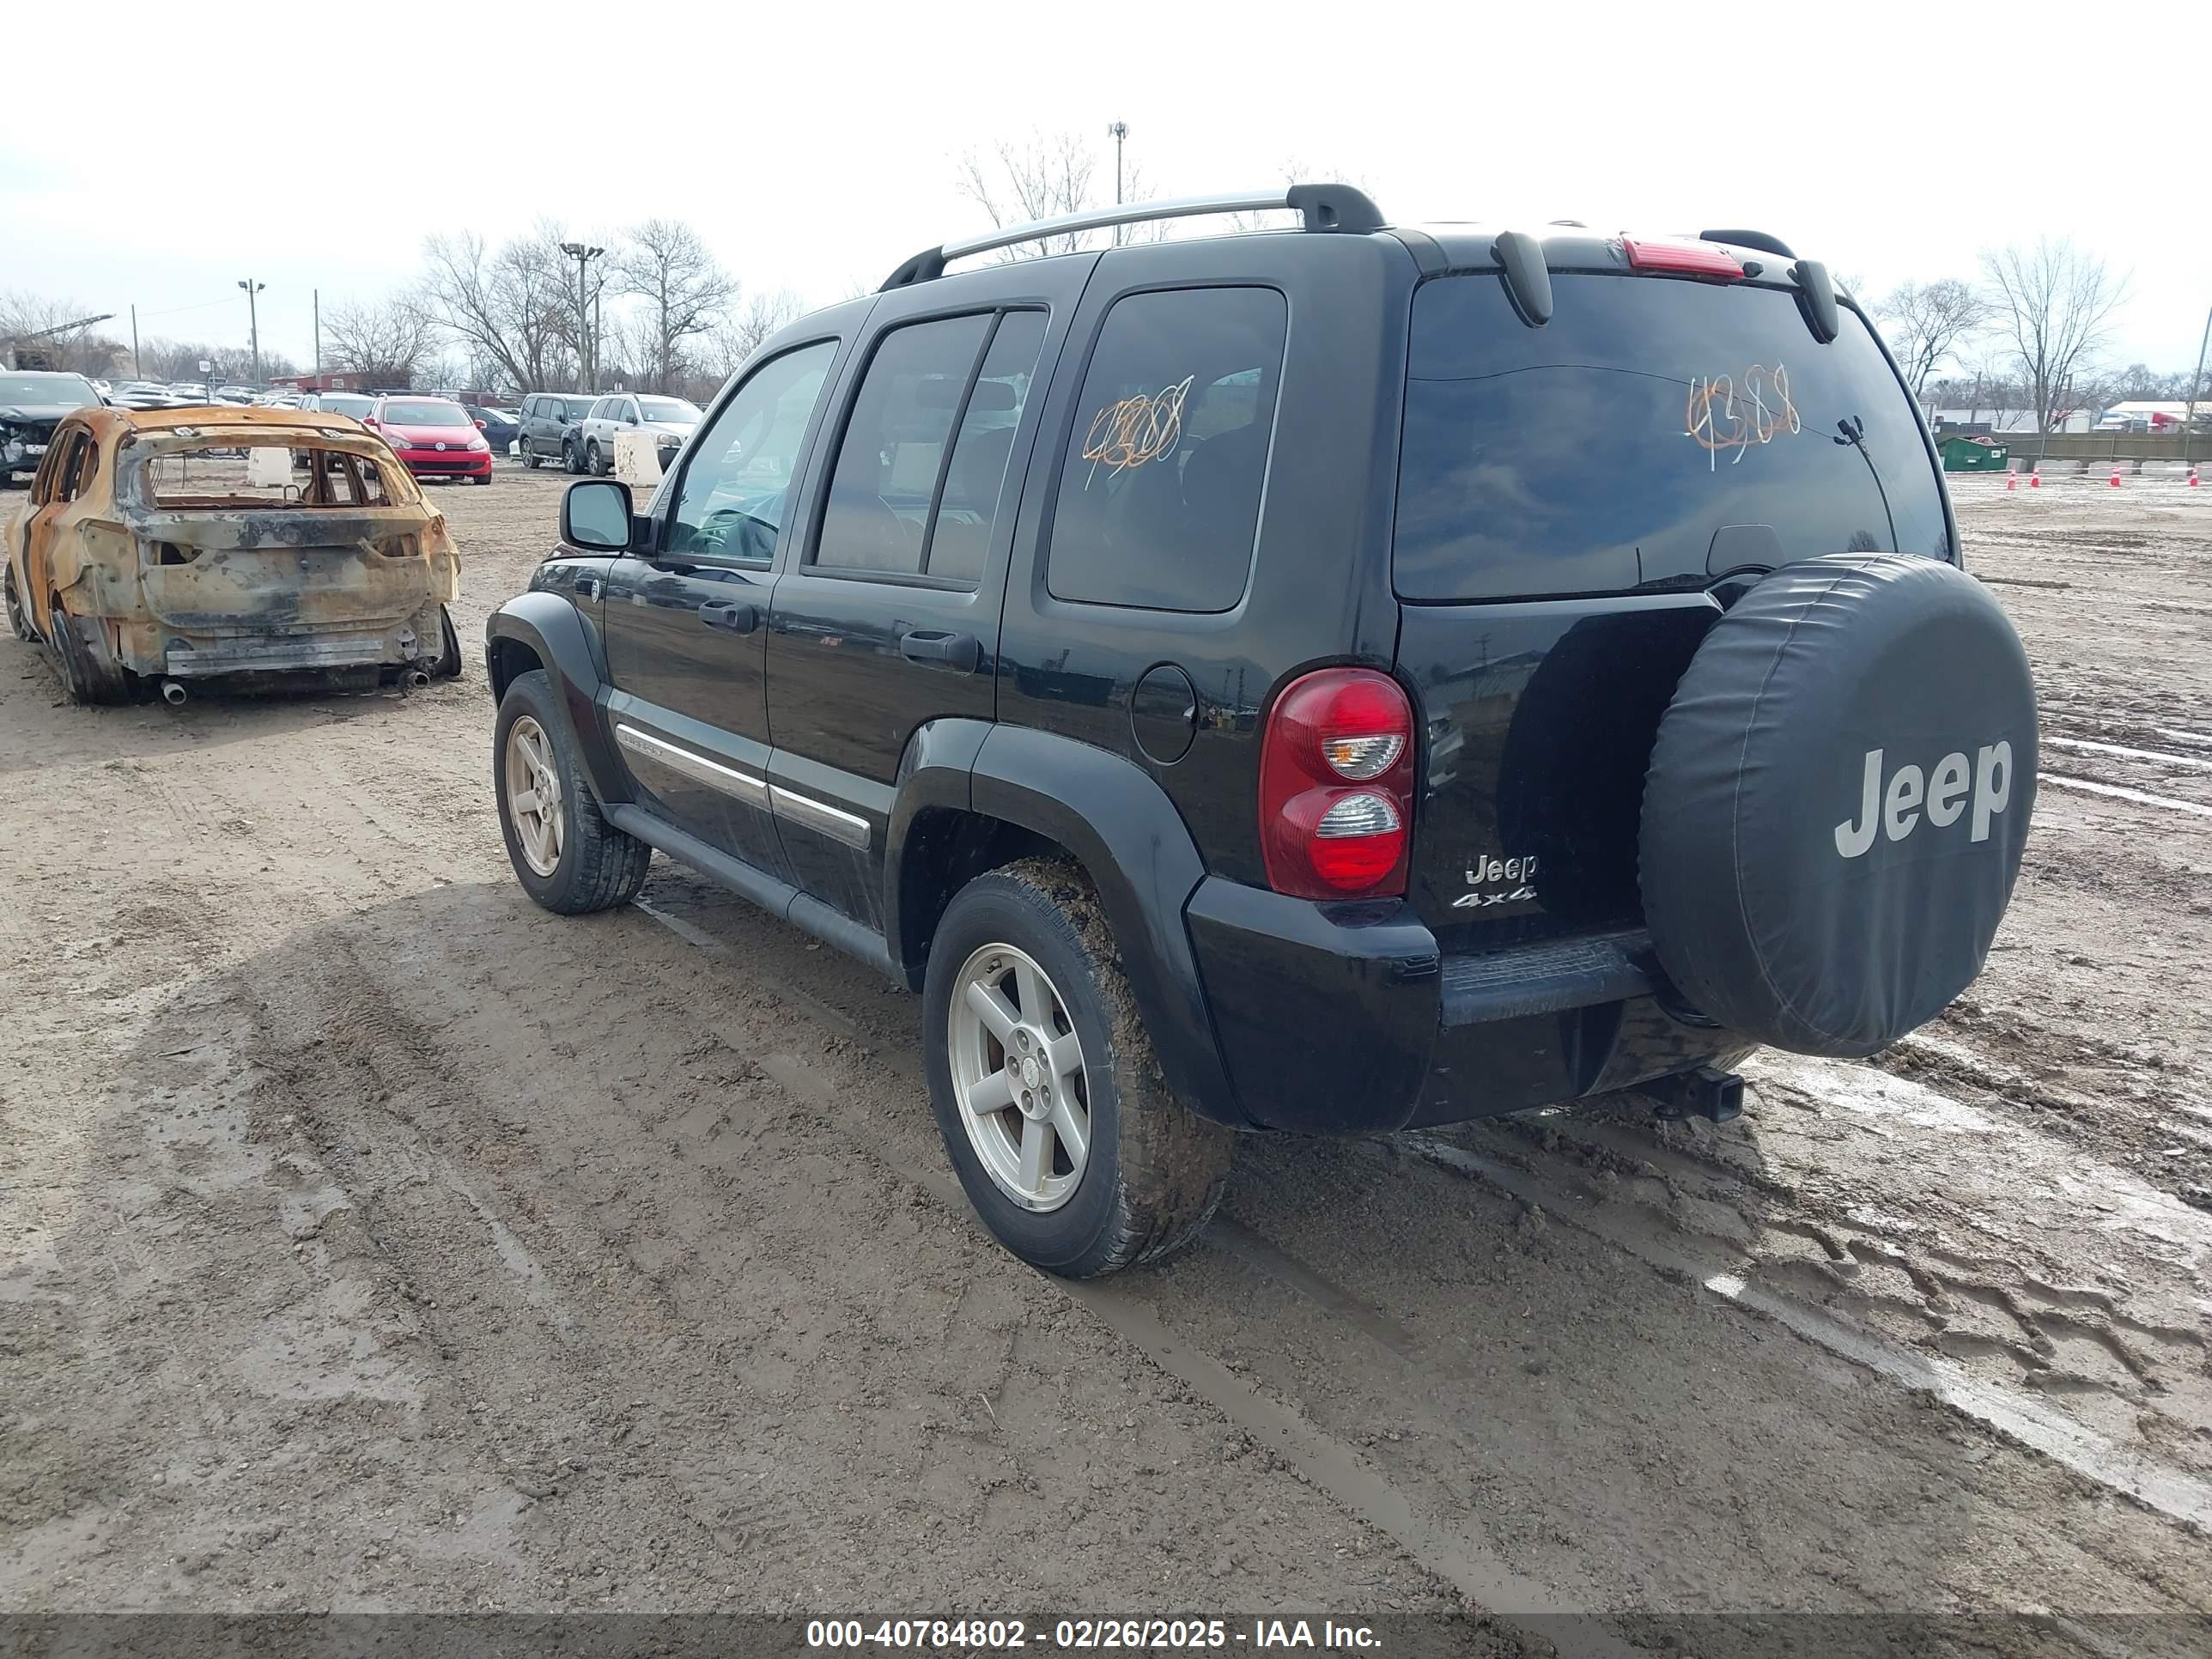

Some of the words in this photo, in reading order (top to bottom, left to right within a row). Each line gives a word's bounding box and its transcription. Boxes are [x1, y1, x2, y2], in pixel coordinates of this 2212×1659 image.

[1834, 740, 2013, 858] Jeep
[1465, 854, 1537, 884] Jeep
[1452, 885, 1538, 908] 4x4
